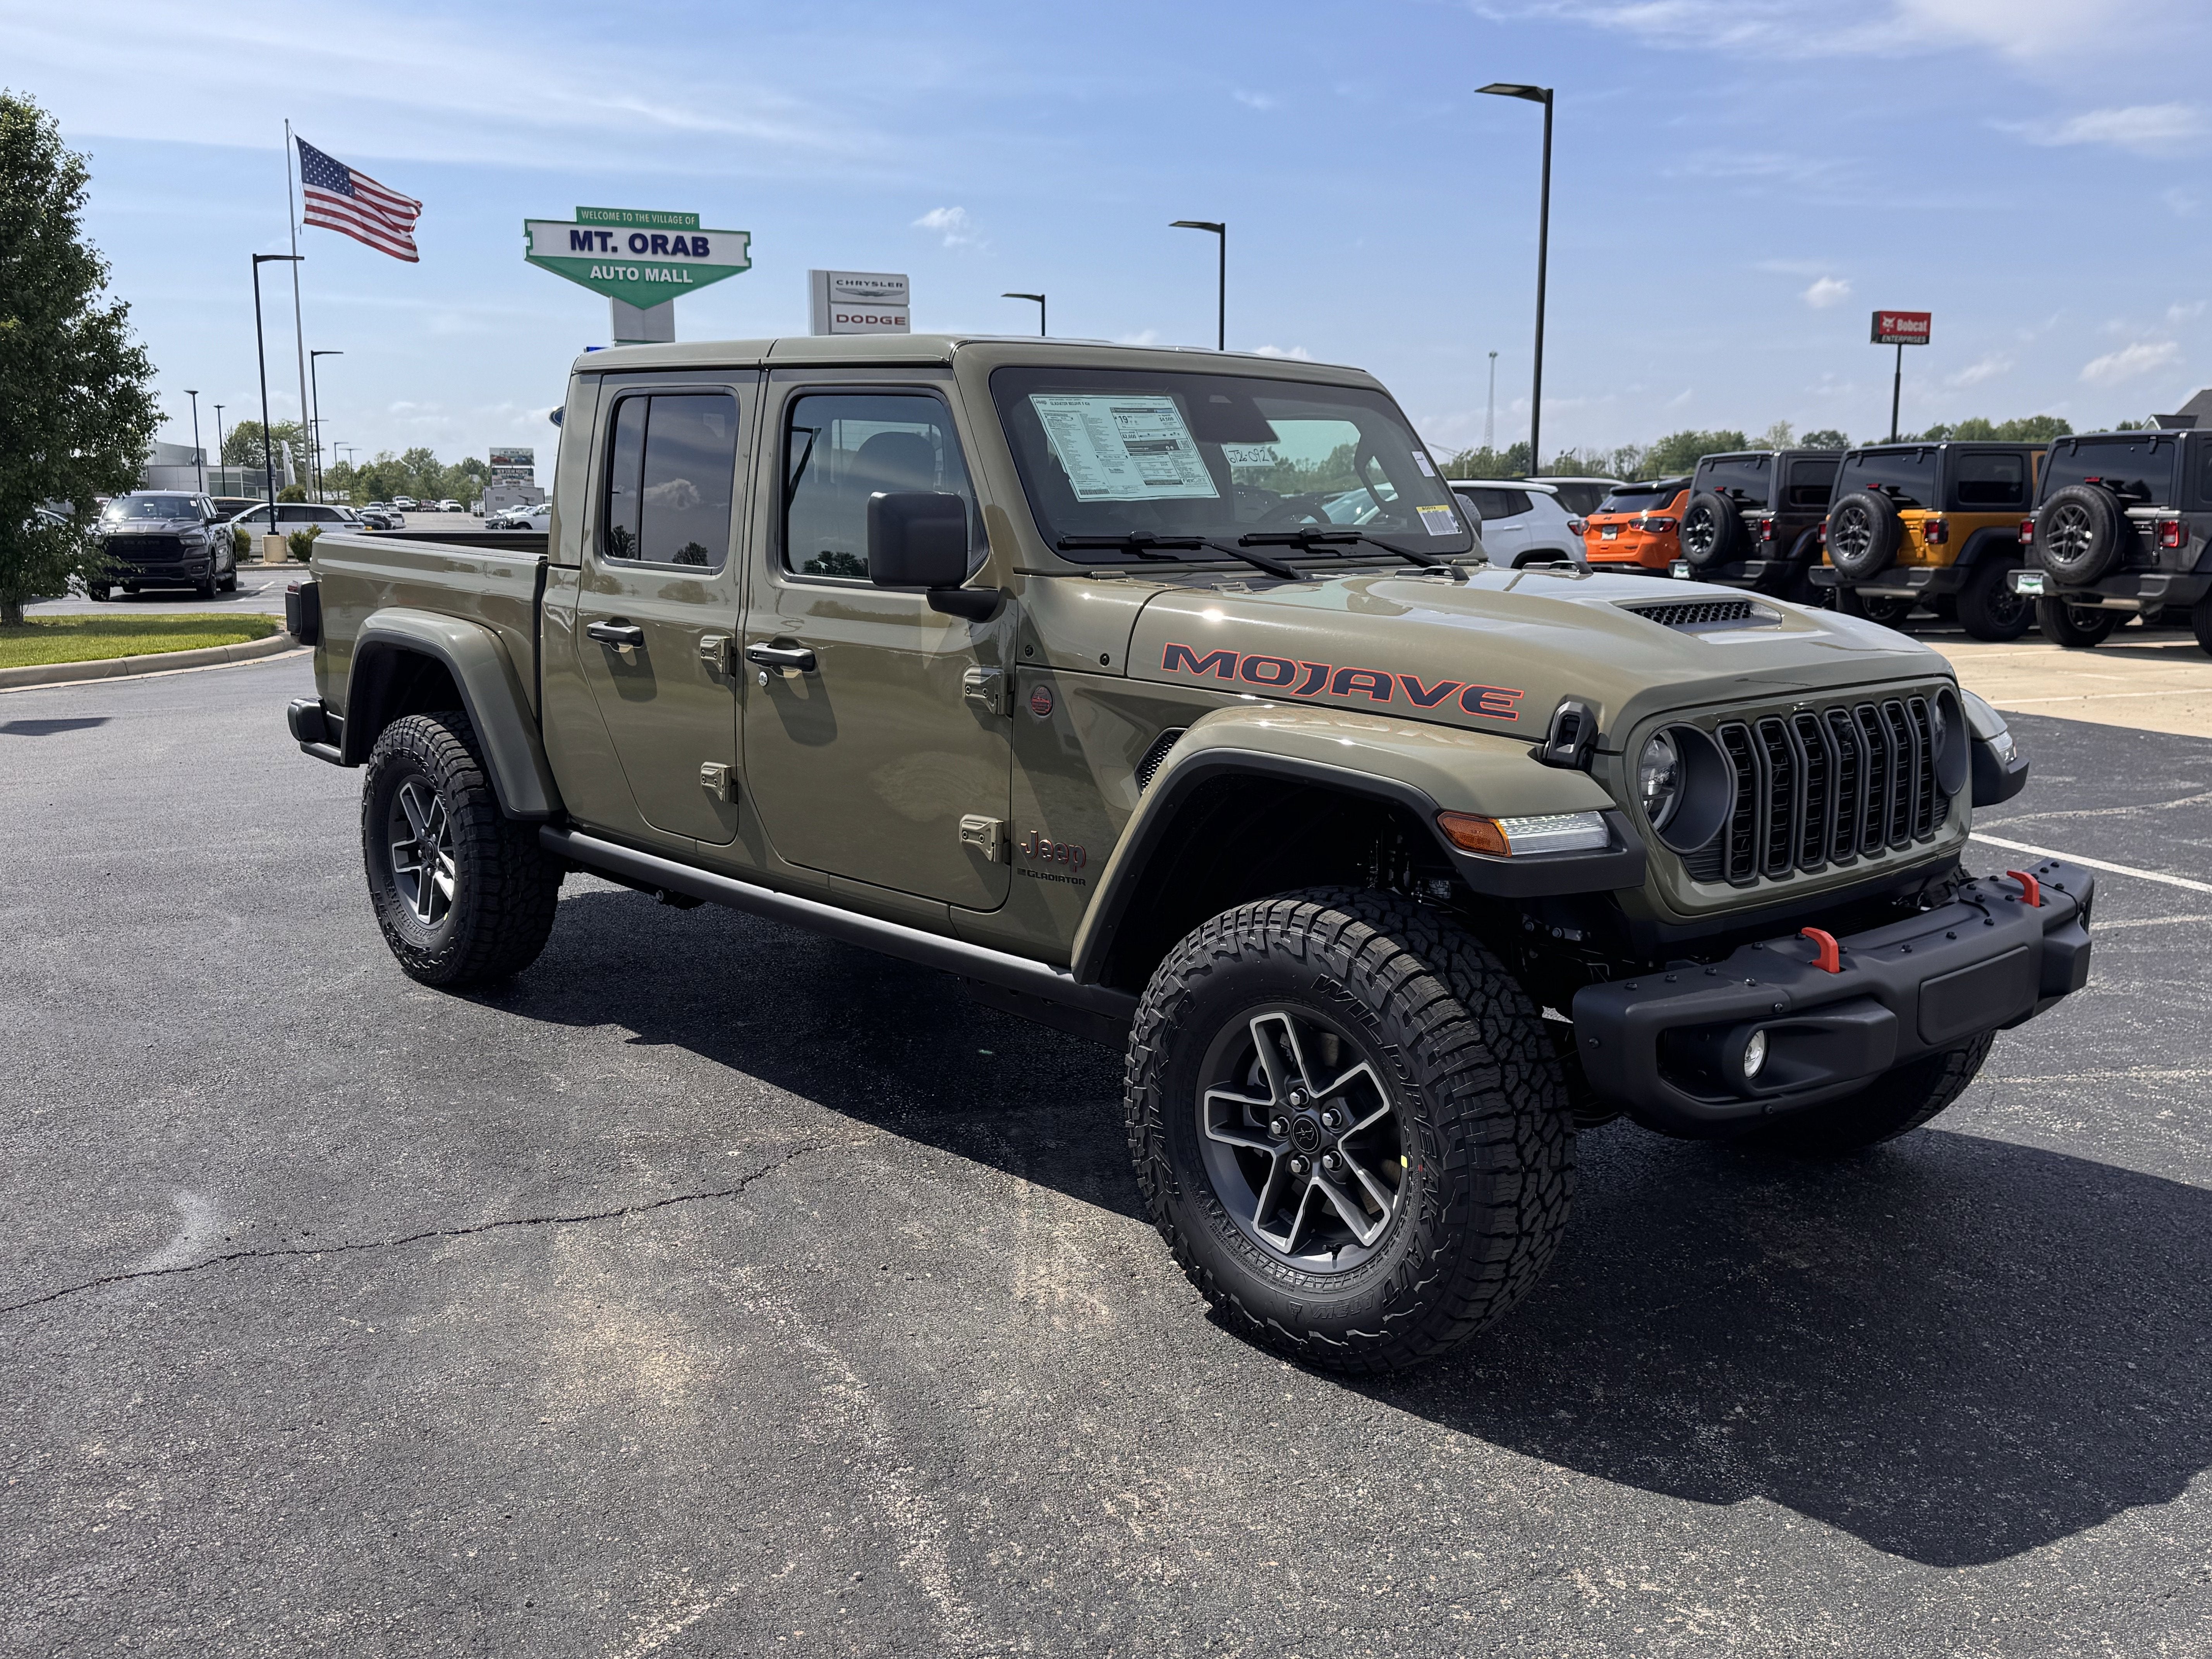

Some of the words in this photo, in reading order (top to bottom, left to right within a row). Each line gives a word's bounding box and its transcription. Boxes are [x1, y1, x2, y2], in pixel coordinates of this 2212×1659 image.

[581, 210, 620, 221] WELCOME
[622, 212, 632, 222] TO
[635, 213, 649, 223] THE
[652, 214, 683, 224] VILLAGE
[685, 216, 696, 225] OF
[570, 230, 618, 252] MT.
[629, 233, 710, 257] ORAB
[590, 266, 639, 281] AUTO
[645, 268, 693, 283] MALL
[836, 280, 903, 288] CHRYSLER
[836, 314, 906, 326] DODGE
[1161, 642, 1524, 721] MOJAVE
[1020, 830, 1087, 873] Jeep
[1027, 869, 1087, 886] GLADIATOR
